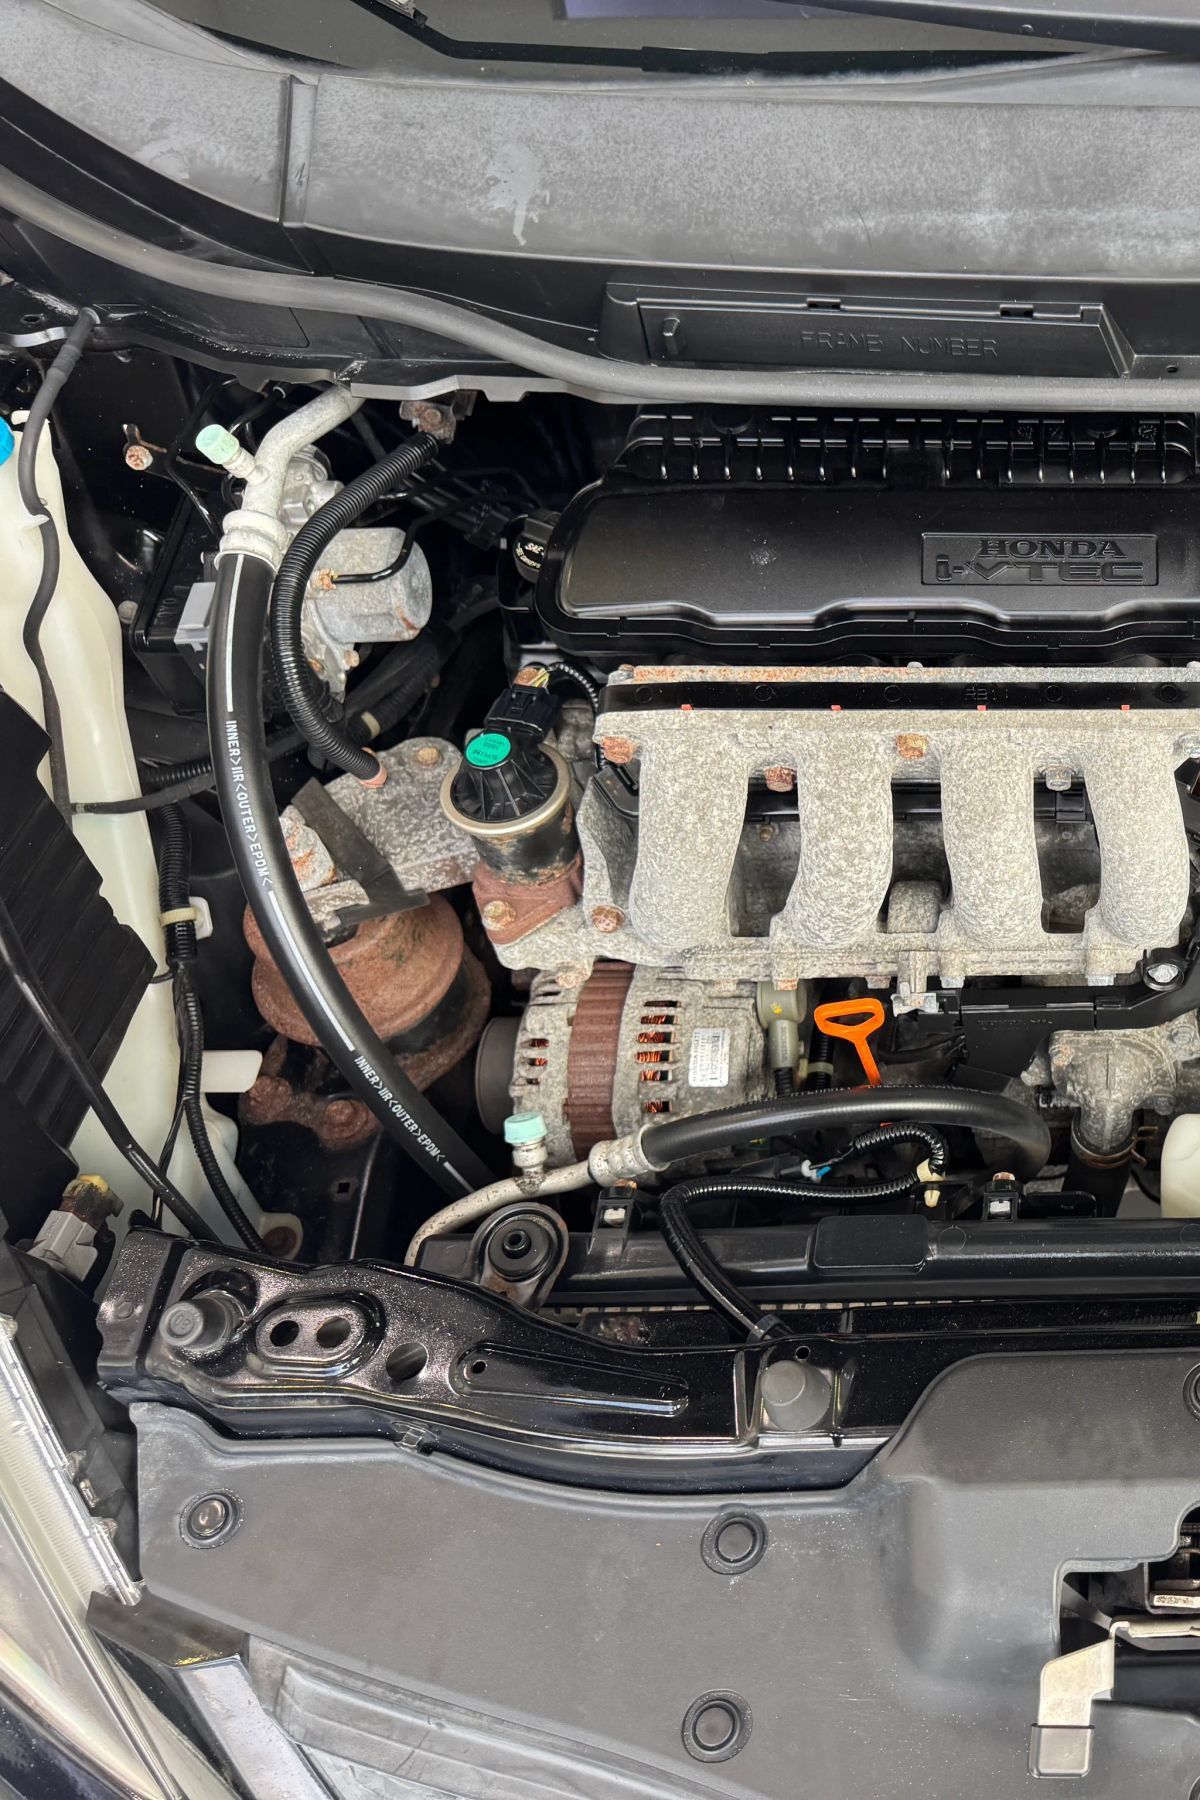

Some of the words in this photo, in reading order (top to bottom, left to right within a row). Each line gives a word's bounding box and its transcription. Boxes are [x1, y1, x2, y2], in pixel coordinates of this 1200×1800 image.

[800, 331, 883, 352] FRAME
[901, 335, 998, 357] NUMBER
[978, 540, 1128, 560] HONDA
[935, 554, 1145, 582] i-VTEC
